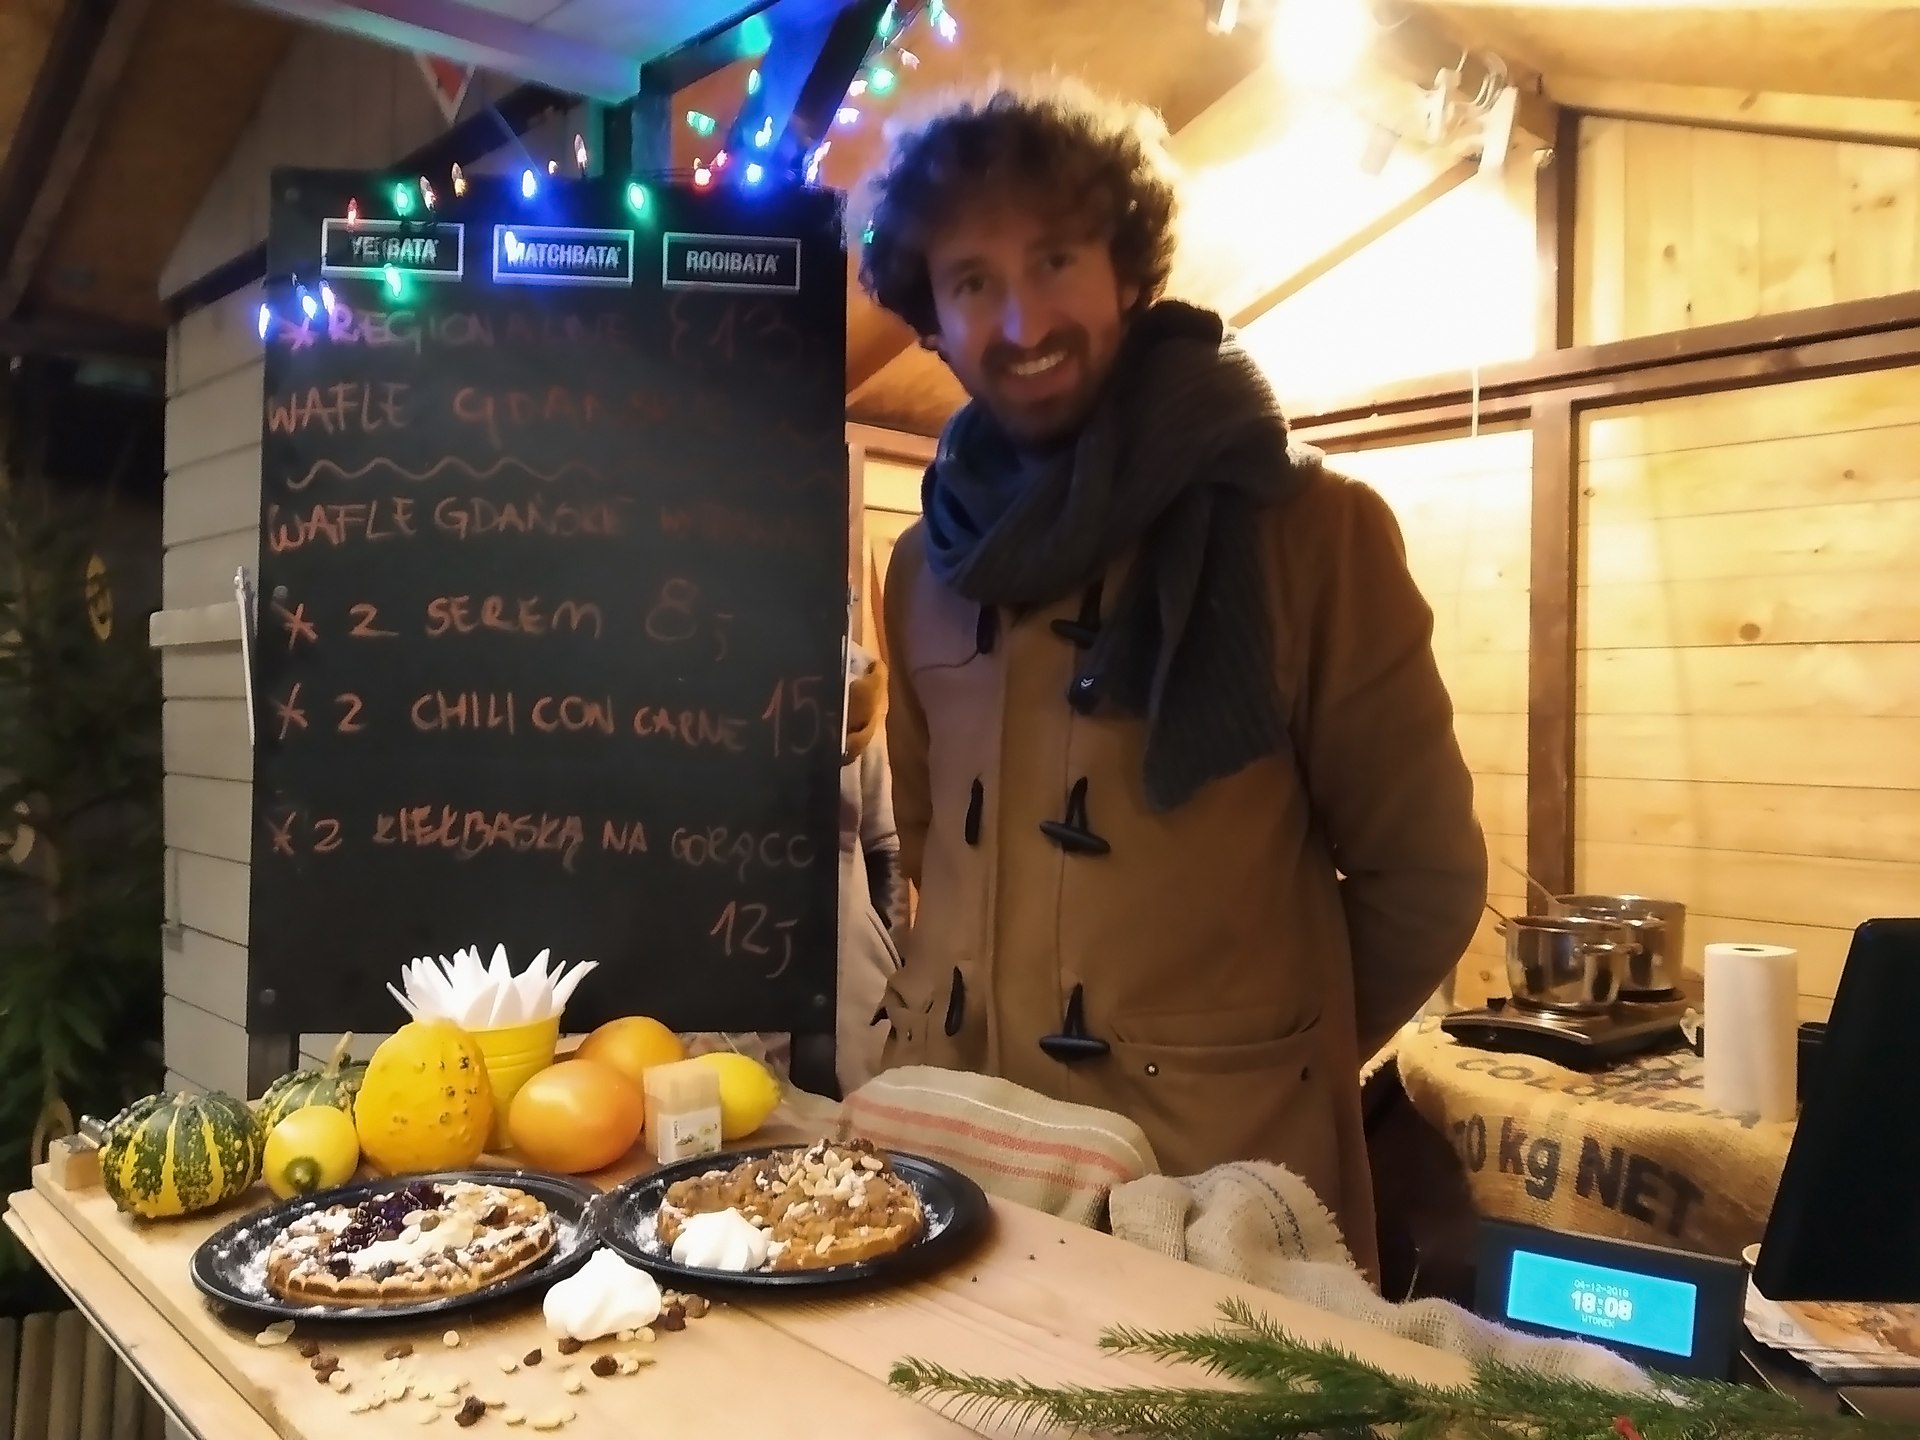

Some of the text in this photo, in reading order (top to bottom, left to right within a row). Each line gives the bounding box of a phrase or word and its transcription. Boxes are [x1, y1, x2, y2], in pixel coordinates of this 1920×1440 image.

[686, 249, 779, 273] ROOIBATA
[268, 382, 413, 434] WAFLE
[268, 497, 416, 552] WAFLE
[425, 594, 601, 638] SEREM
[411, 689, 515, 735] CHILI
[531, 694, 615, 736] CON
[633, 704, 749, 752] CARNE
[602, 819, 649, 855] NA
[1575, 1135, 1706, 1238] NET
[1571, 1290, 1633, 1321] 18:08
